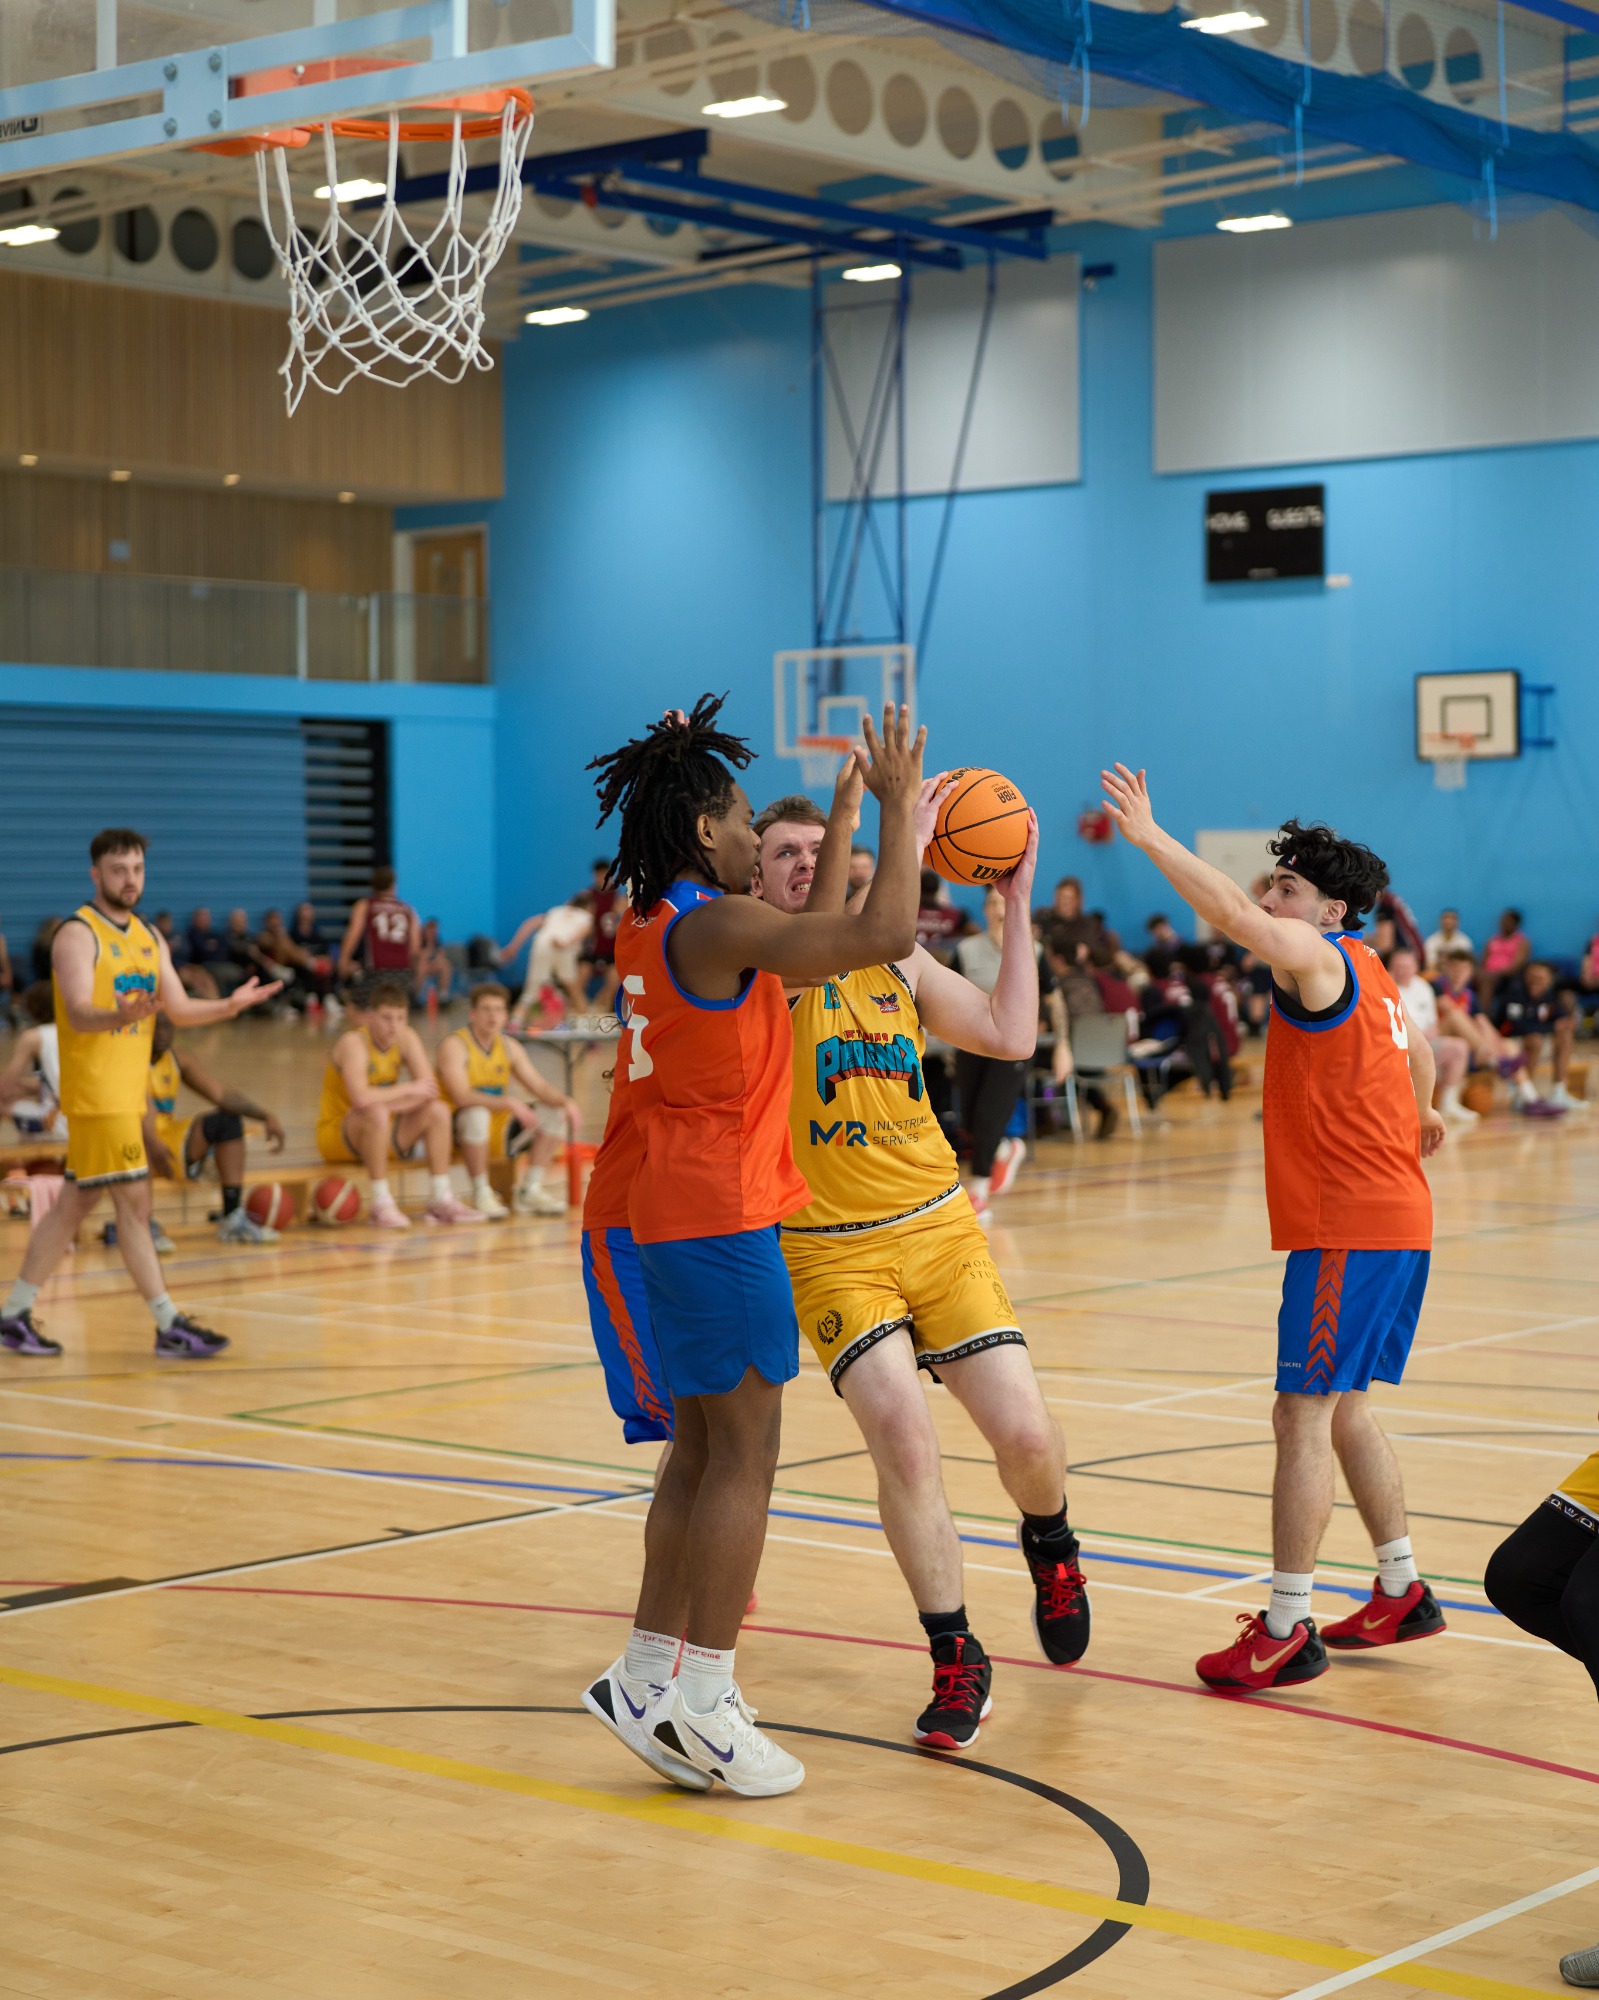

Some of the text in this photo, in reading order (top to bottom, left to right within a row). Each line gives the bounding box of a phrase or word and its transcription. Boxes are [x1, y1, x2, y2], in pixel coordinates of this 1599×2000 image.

[996, 789, 1017, 804] FIBA
[372, 911, 408, 943] 12
[816, 1033, 924, 1106] PHOENIX
[1273, 1588, 1311, 1597] DONNA
[632, 1629, 676, 1647] Supreme
[684, 1646, 721, 1660] upreme
